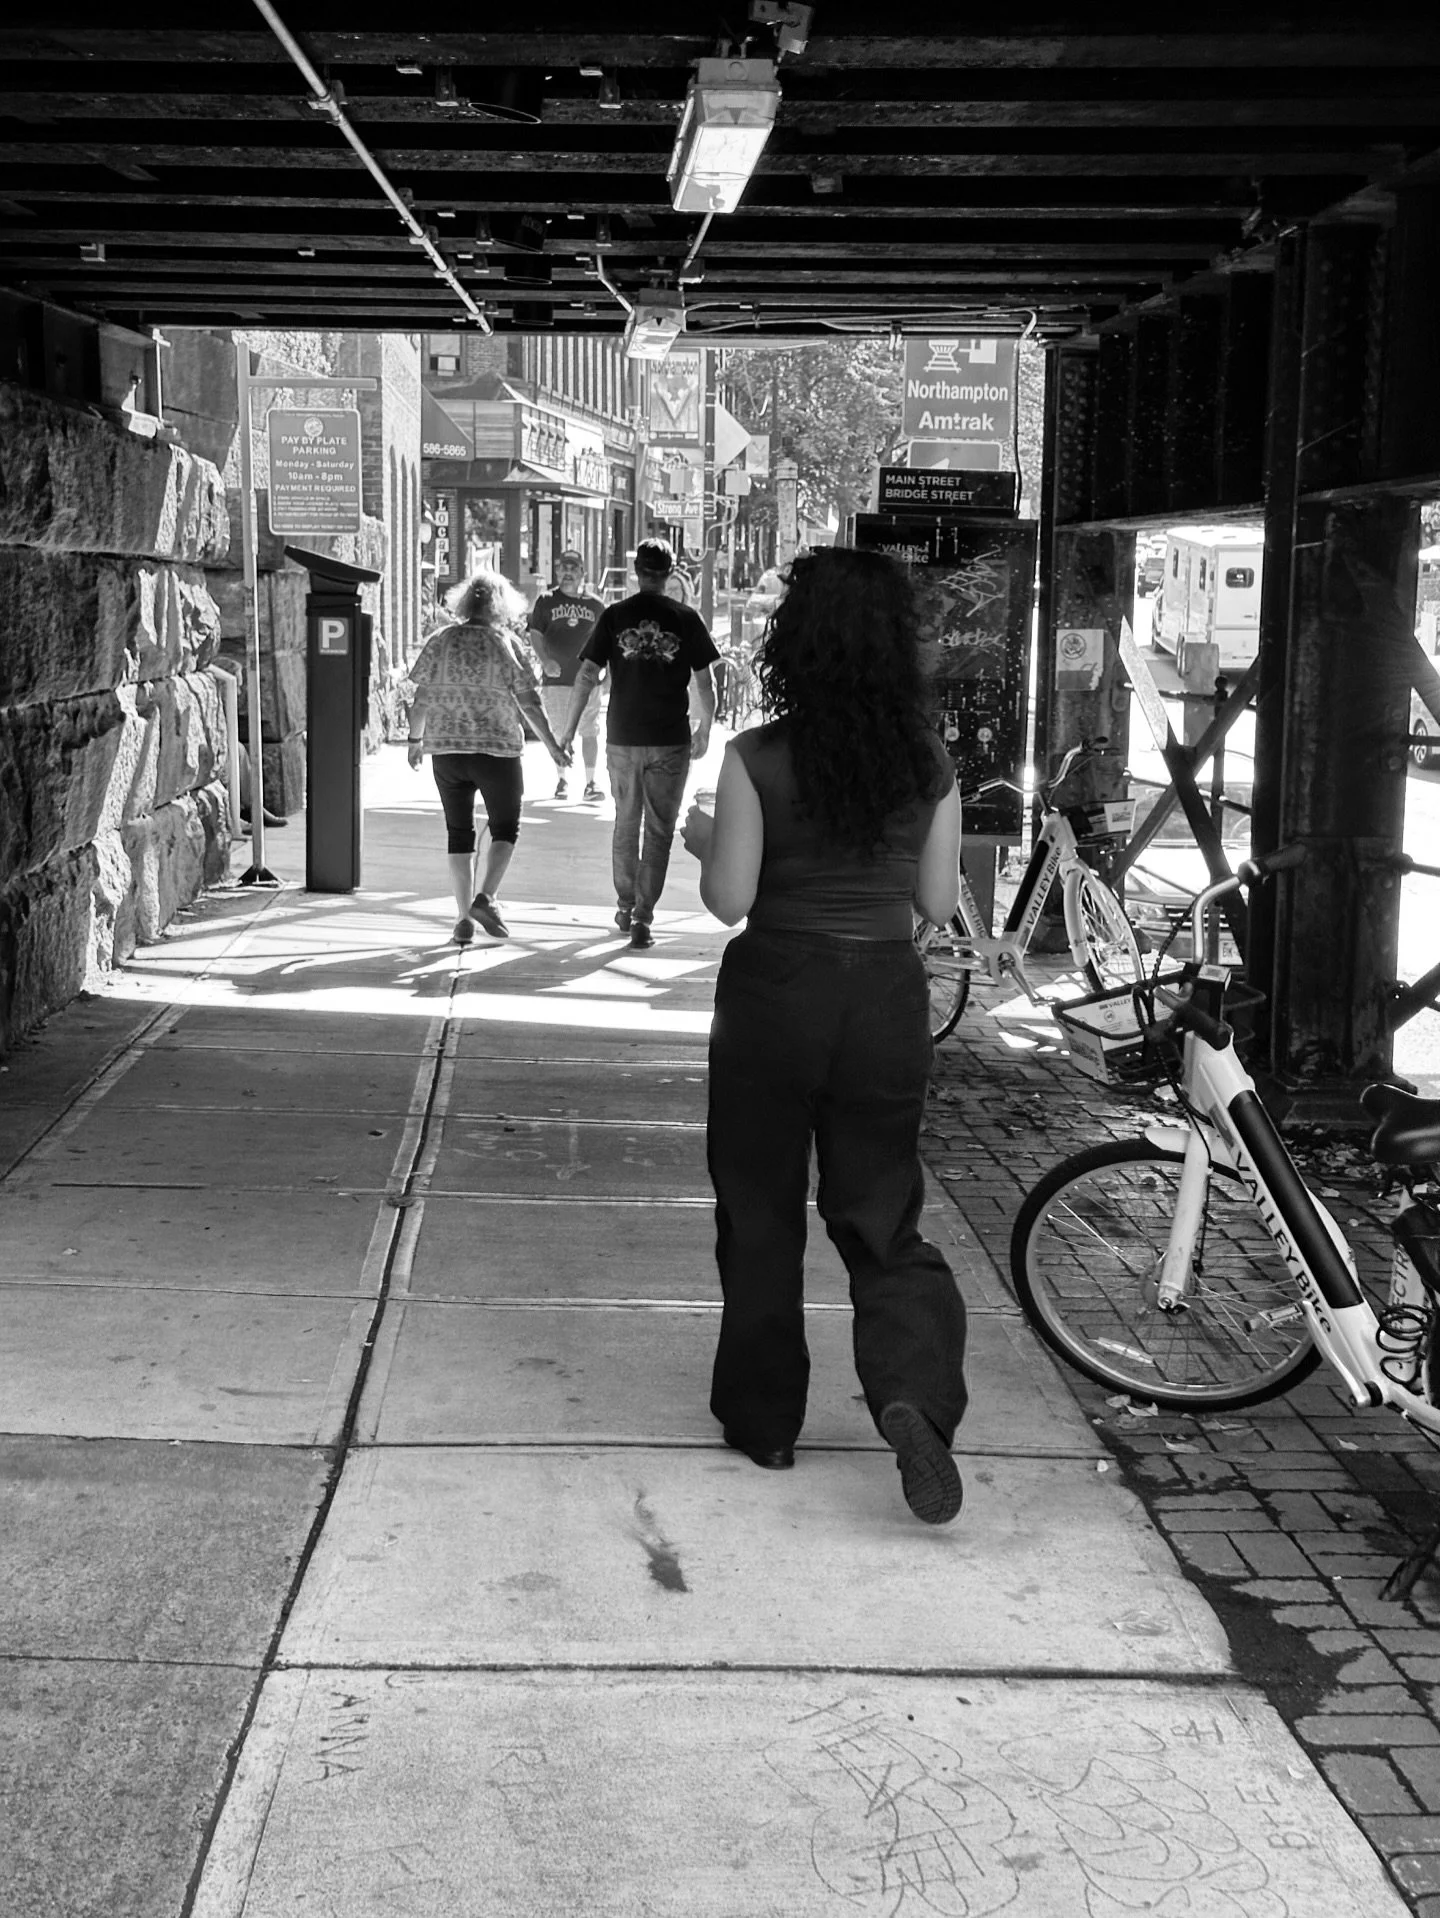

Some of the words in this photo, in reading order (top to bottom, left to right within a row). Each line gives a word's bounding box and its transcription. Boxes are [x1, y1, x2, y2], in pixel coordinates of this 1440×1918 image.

[907, 379, 1009, 404] Northampton
[918, 410, 995, 432] Amtrak
[281, 435, 300, 445] PAY
[301, 435, 315, 445] BY
[316, 436, 348, 446] PLATE
[292, 446, 337, 455] PARKING
[275, 459, 309, 470] Monday
[316, 460, 355, 470] Saturday
[288, 471, 313, 481] 10am
[885, 474, 916, 485] MAIN
[918, 475, 962, 486] STREET
[275, 484, 312, 492] PAYMENT
[314, 484, 356, 493] REQUIRED
[885, 488, 928, 499] BRIDGE
[931, 489, 974, 501] STREET
[322, 620, 345, 649] P
[1027, 874, 1050, 926] VALLEY
[1236, 1152, 1298, 1264] VALLEY
